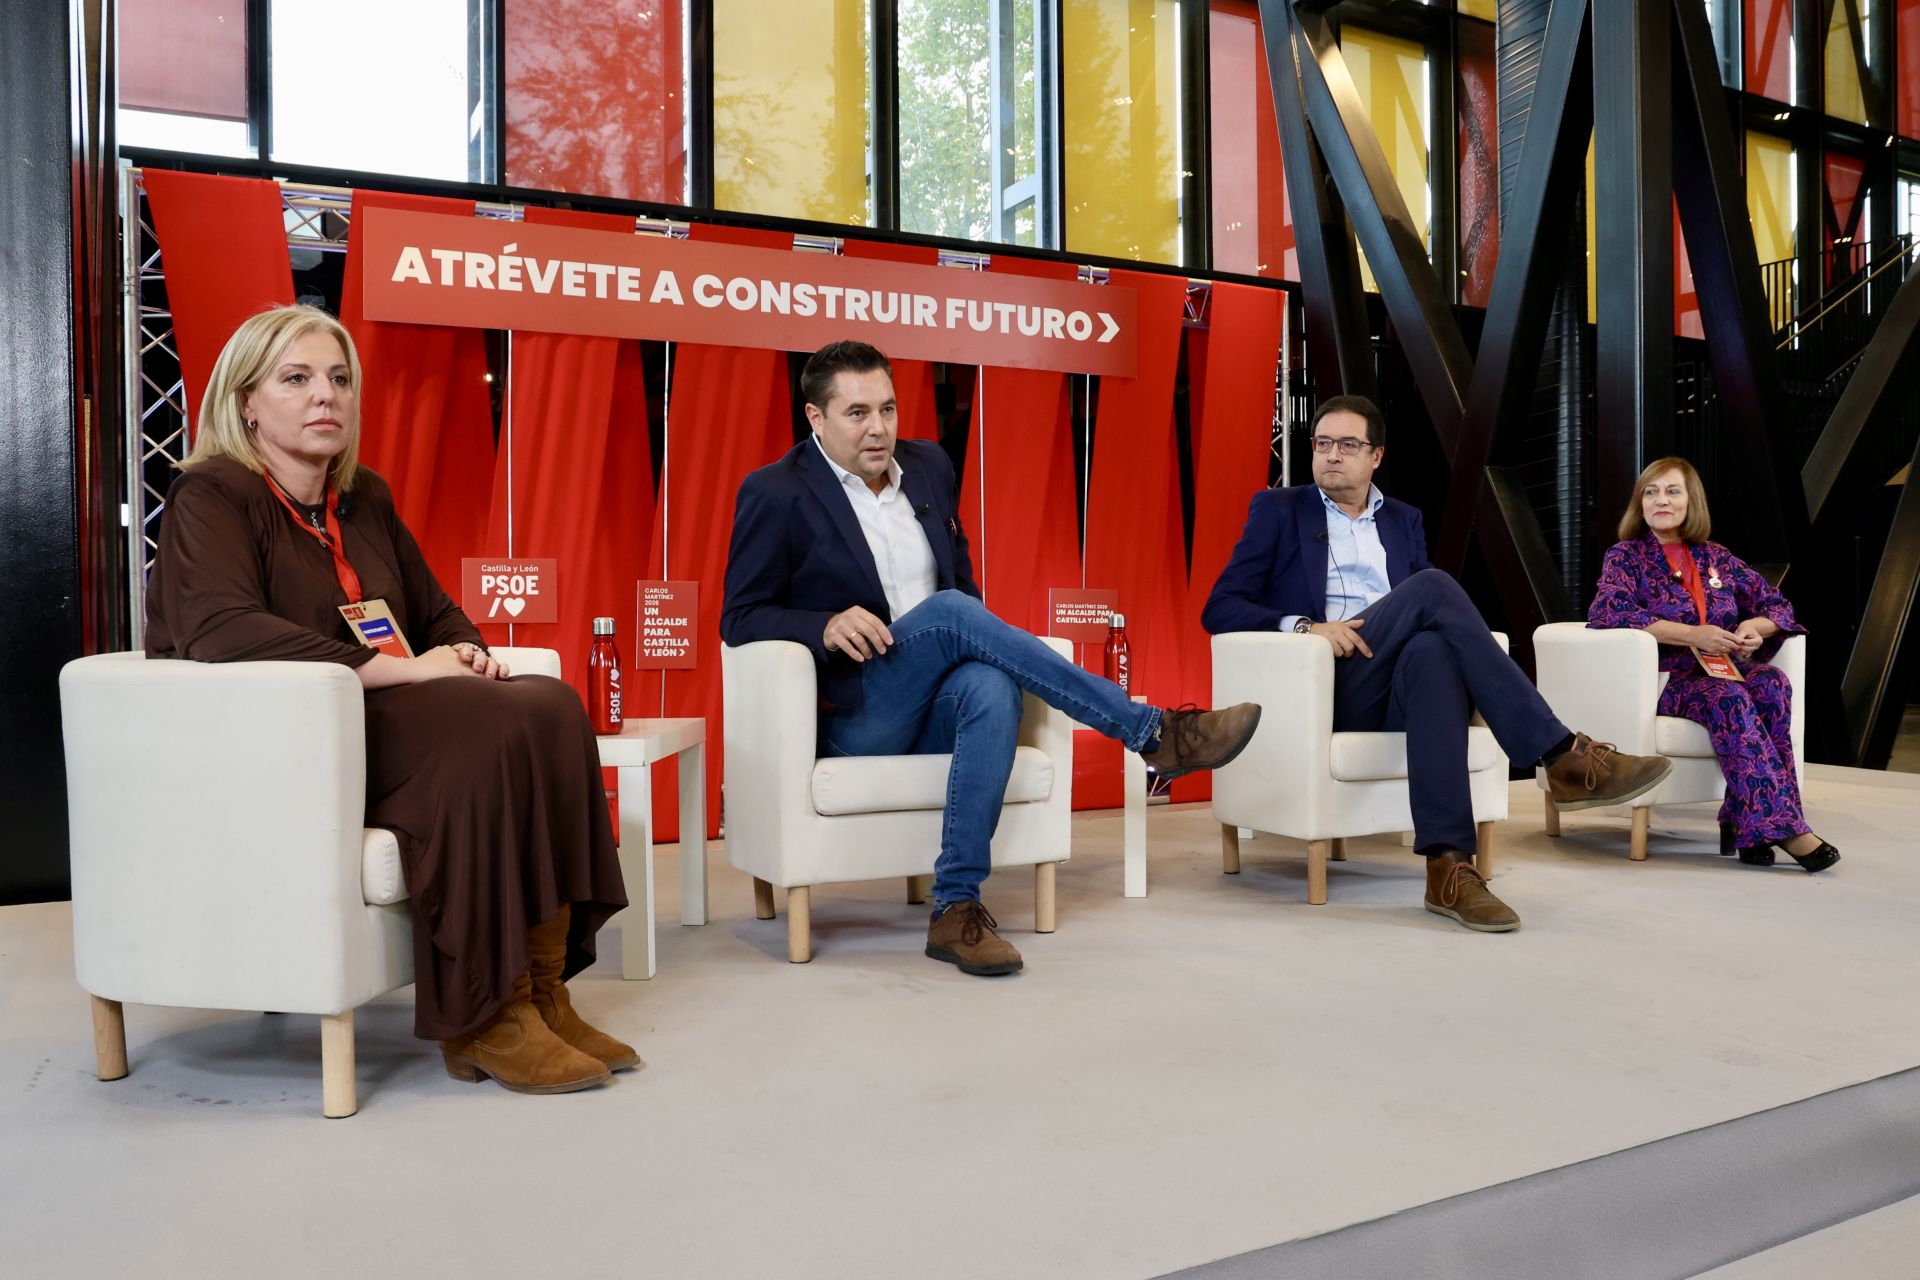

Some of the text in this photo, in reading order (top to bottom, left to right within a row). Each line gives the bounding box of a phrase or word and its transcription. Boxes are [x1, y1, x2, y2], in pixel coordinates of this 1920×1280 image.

[391, 242, 1093, 341] ATRÉVETE A CONSTRUIR FUTURO
[481, 564, 539, 574] Castilla y León
[481, 575, 539, 595] PSOE
[644, 607, 659, 616] UN
[644, 618, 688, 626] ALCALDE
[643, 628, 671, 636] PARA
[643, 638, 690, 647] CASTILLA
[643, 646, 677, 657] Y LEÓN
[610, 691, 621, 723] PSOE
